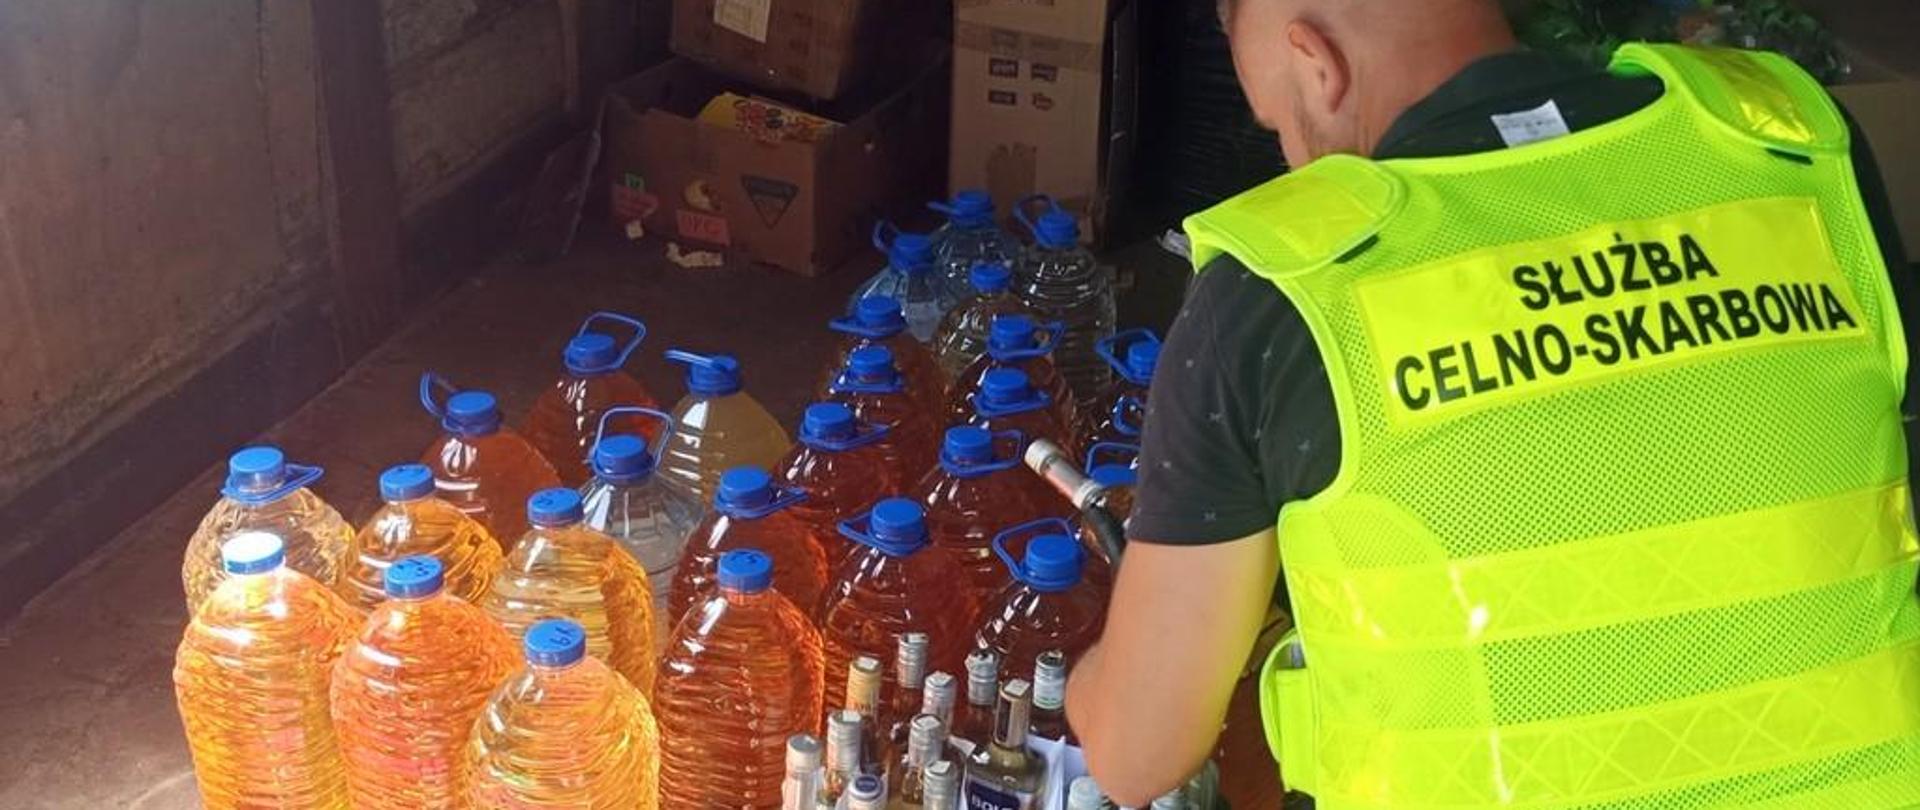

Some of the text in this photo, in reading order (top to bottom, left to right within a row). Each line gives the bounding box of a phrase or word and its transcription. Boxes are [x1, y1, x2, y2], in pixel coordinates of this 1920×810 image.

[1513, 232, 1719, 310] SŁUŻBA
[1394, 283, 1857, 411] CELNO-SKARBOWA
[971, 794, 1013, 810] BOL
